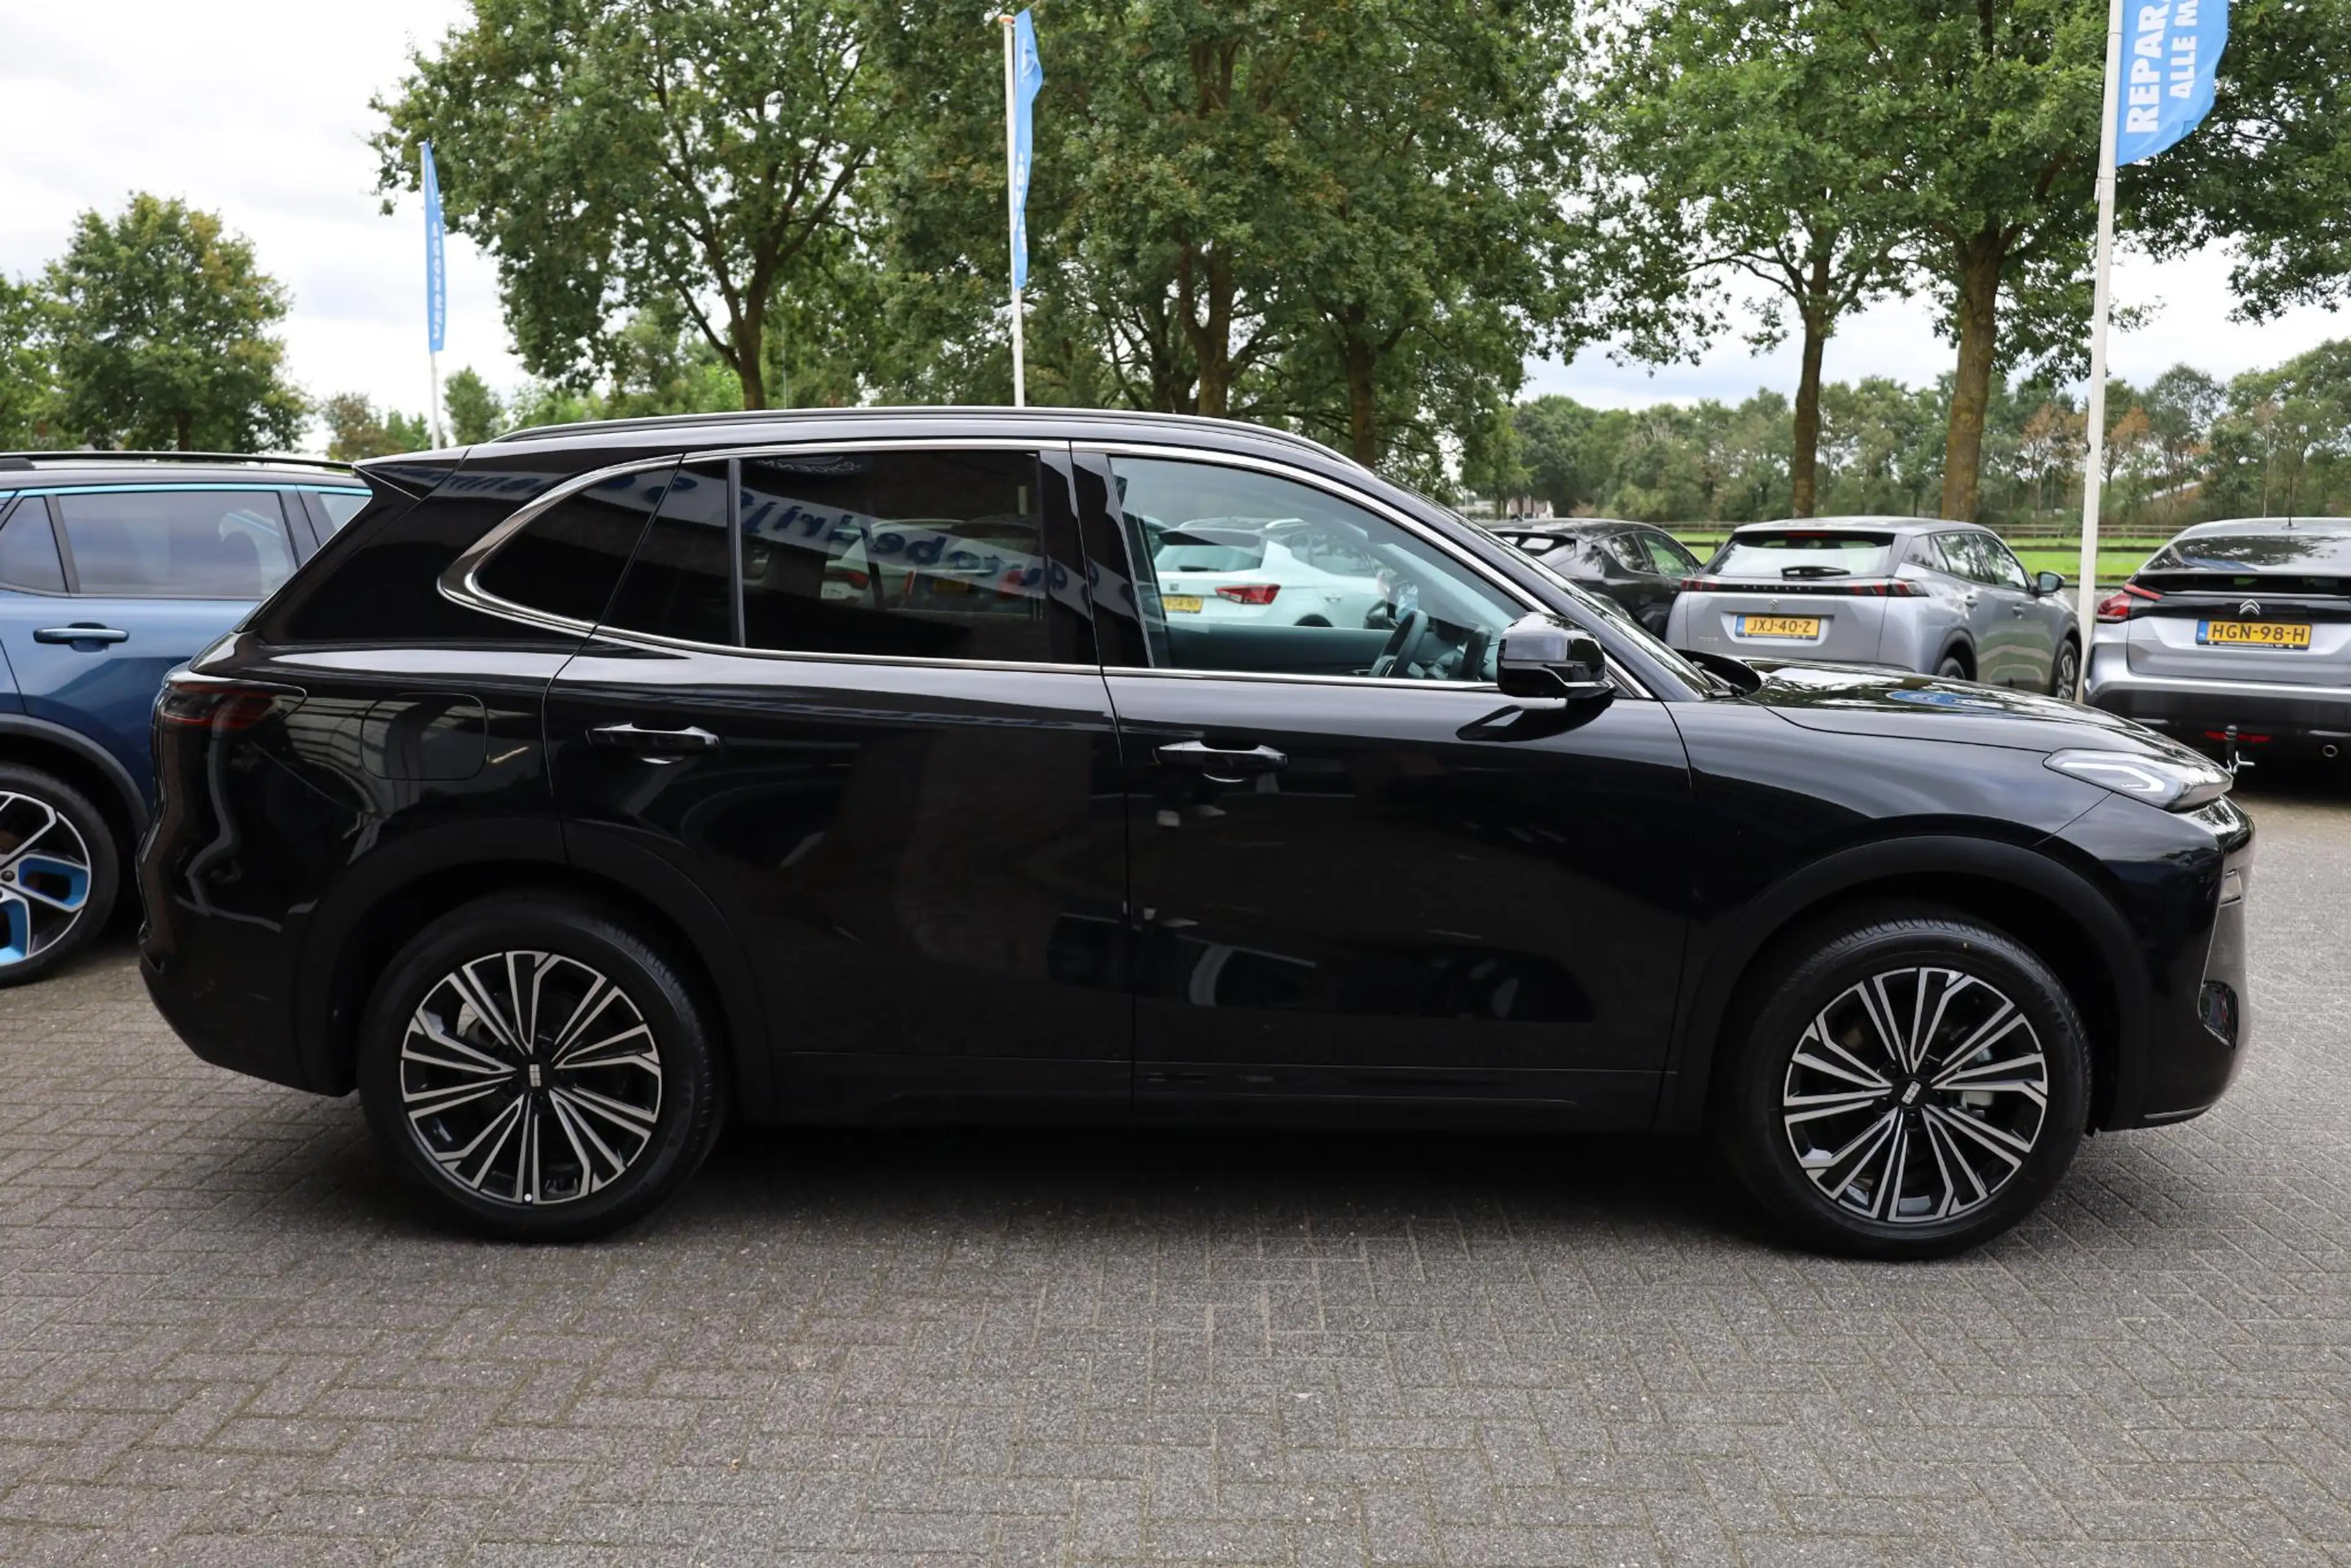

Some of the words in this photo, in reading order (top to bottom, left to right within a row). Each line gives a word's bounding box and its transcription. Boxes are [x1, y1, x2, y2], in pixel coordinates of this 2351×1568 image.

[2126, 0, 2171, 133] REPAR
[2170, 36, 2196, 98] ALLE
[1750, 620, 1811, 633] JXJ-40-Z
[2212, 625, 2306, 642] HGN-98-H
